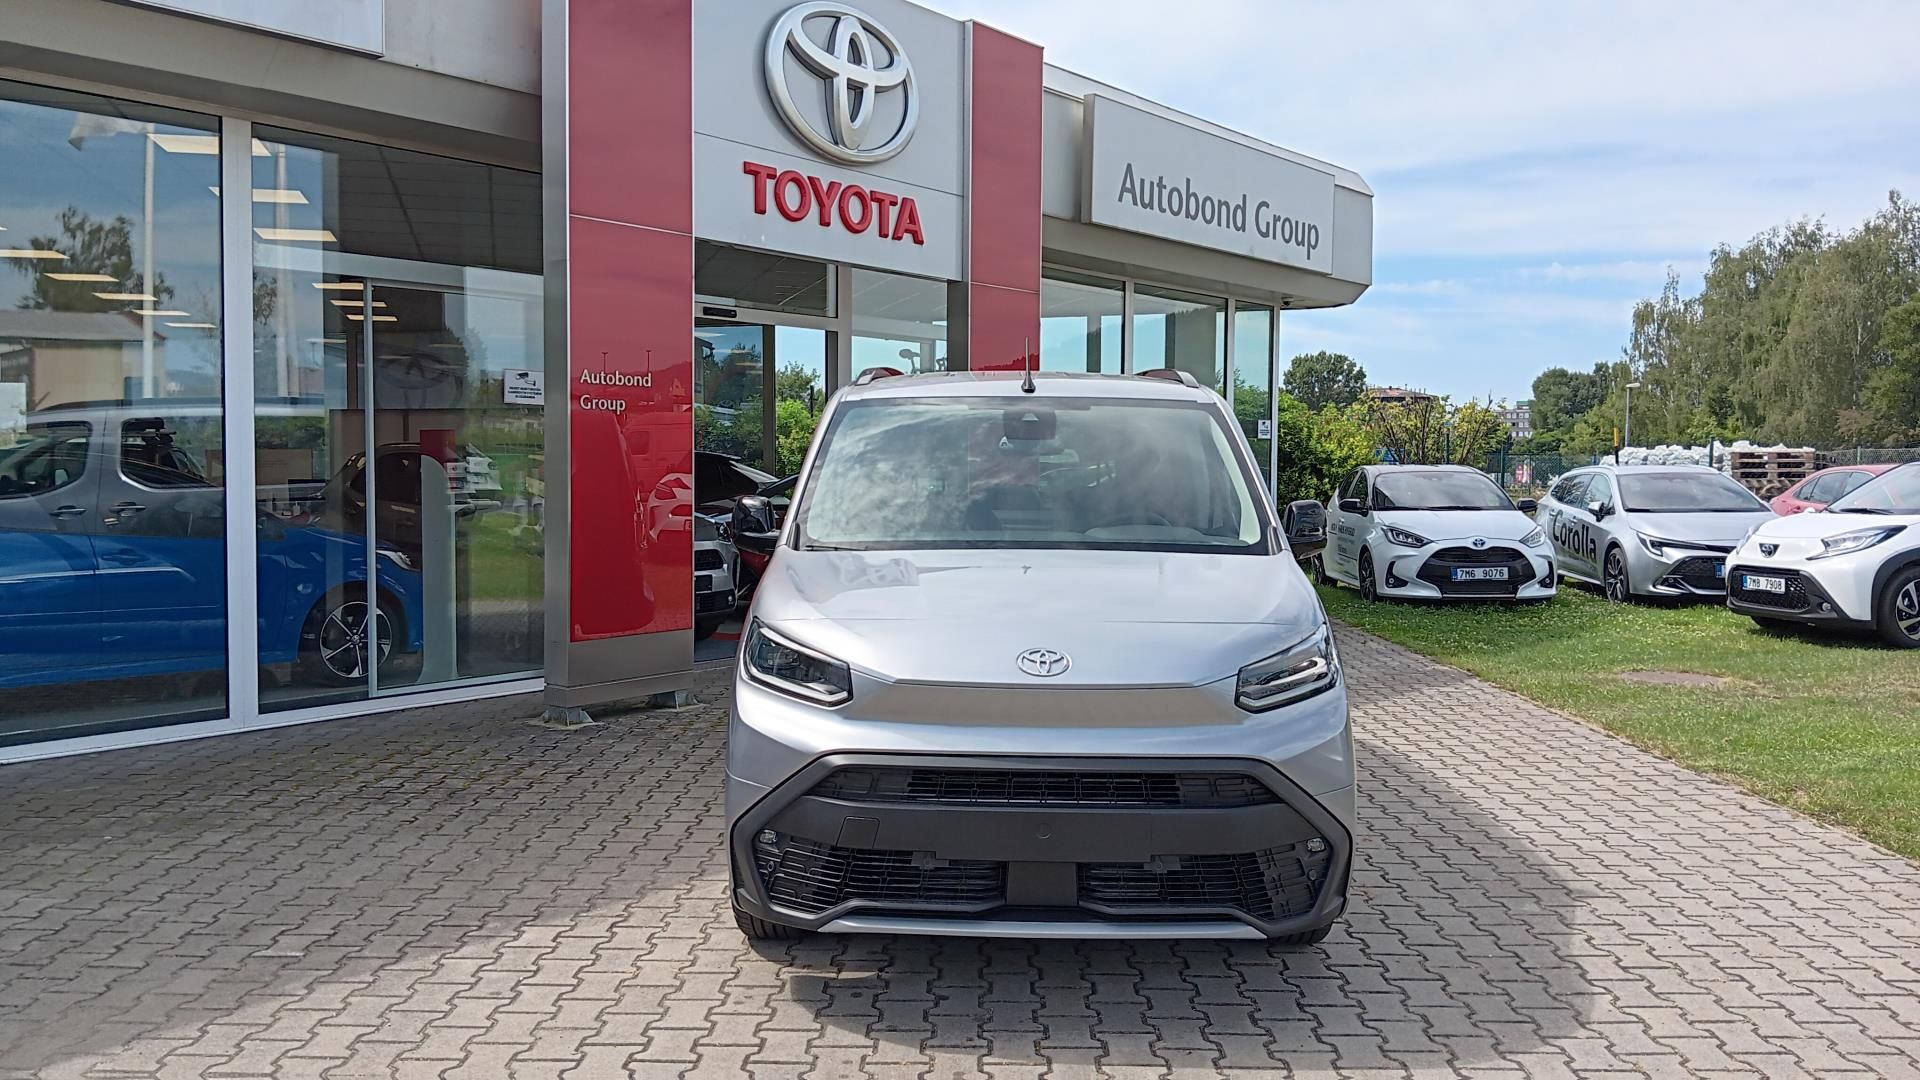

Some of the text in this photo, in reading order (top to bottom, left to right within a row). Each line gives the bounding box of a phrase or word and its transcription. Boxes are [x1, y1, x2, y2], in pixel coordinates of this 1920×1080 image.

[743, 160, 924, 246] TOYOTA
[1117, 162, 1319, 260] Autobond Group
[580, 369, 652, 387] Autobond
[580, 395, 626, 415] Group
[1552, 509, 1598, 564] Corolla
[1459, 569, 1505, 579] 7M6 9076
[1765, 578, 1782, 590] 7908
